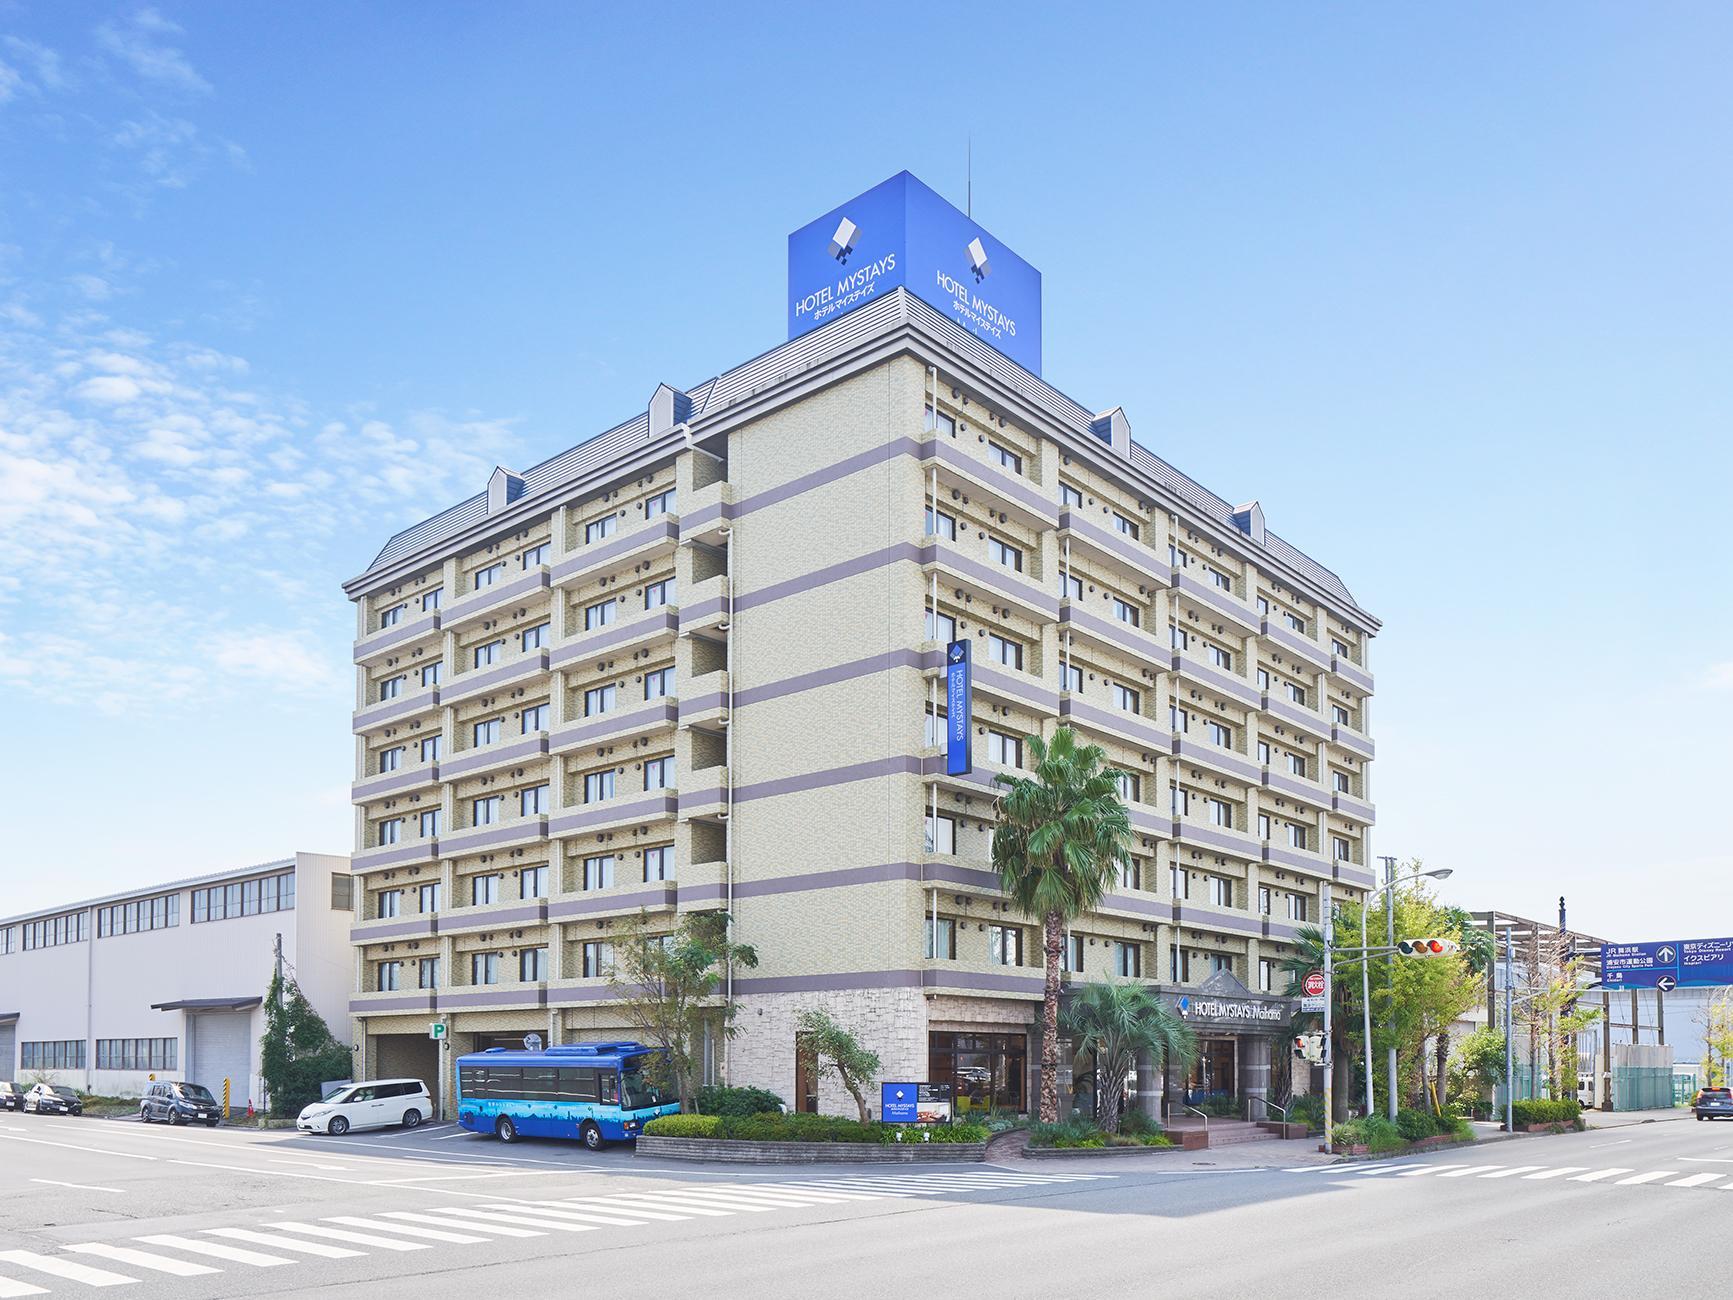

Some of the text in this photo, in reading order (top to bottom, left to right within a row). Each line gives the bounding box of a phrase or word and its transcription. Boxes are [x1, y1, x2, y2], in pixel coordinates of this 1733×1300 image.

[796, 253, 896, 317] HOTEL MYSTAYS
[936, 270, 1016, 336] HOTEL MYSTAYS
[956, 669, 964, 742] HOTEL MYSTAYS
[1683, 941, 1733, 949] 東京ディズニーリ
[1195, 1002, 1217, 1016] HOTEL
[1218, 1003, 1250, 1018] MYSTAYS
[434, 1024, 445, 1038] P
